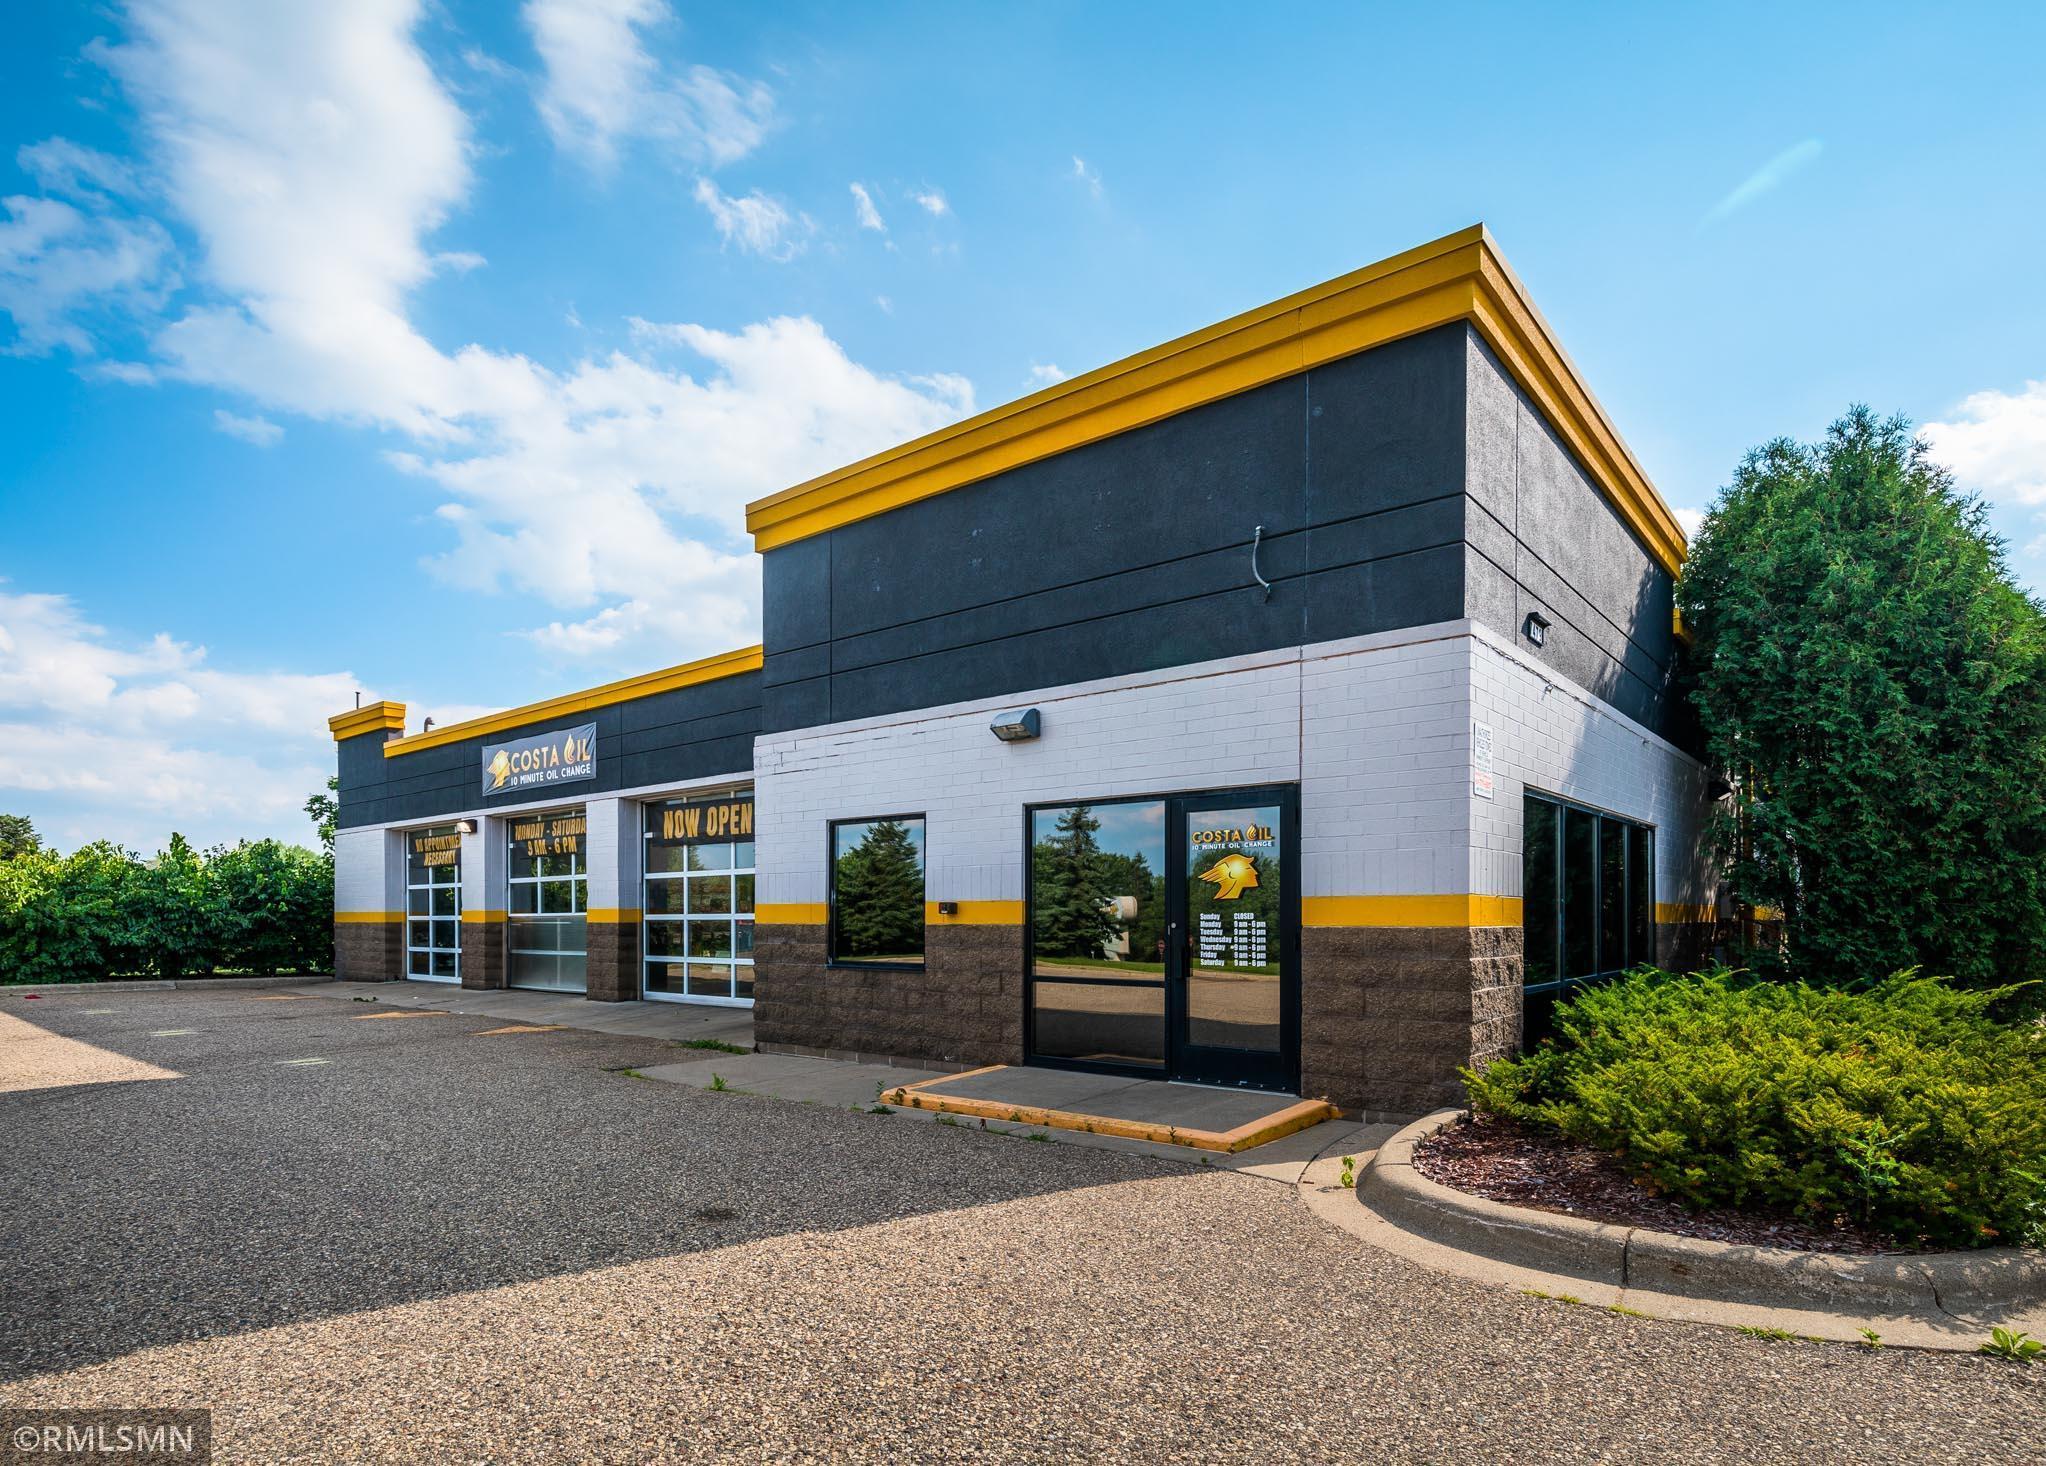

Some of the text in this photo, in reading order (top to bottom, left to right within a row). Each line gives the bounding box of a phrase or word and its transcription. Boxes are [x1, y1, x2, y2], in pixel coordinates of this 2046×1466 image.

[511, 744, 560, 774] COSTA
[511, 764, 591, 786] 10 MINUTE OIL CHANGE
[663, 803, 753, 840] NOW OPEN
[515, 822, 545, 840] MONDAY
[1192, 828, 1241, 844] COSTA
[528, 840, 533, 856] 9
[554, 838, 561, 853] 6
[562, 836, 577, 853] PM
[1200, 912, 1254, 920] Sunday CLOSED
[1200, 920, 1222, 928] Monday
[1200, 928, 1223, 936] Tuesday
[1200, 936, 1232, 944] Wednesday
[1200, 944, 1226, 952] Thursday
[1200, 952, 1217, 960] Friday
[1200, 960, 1224, 968] Saturday
